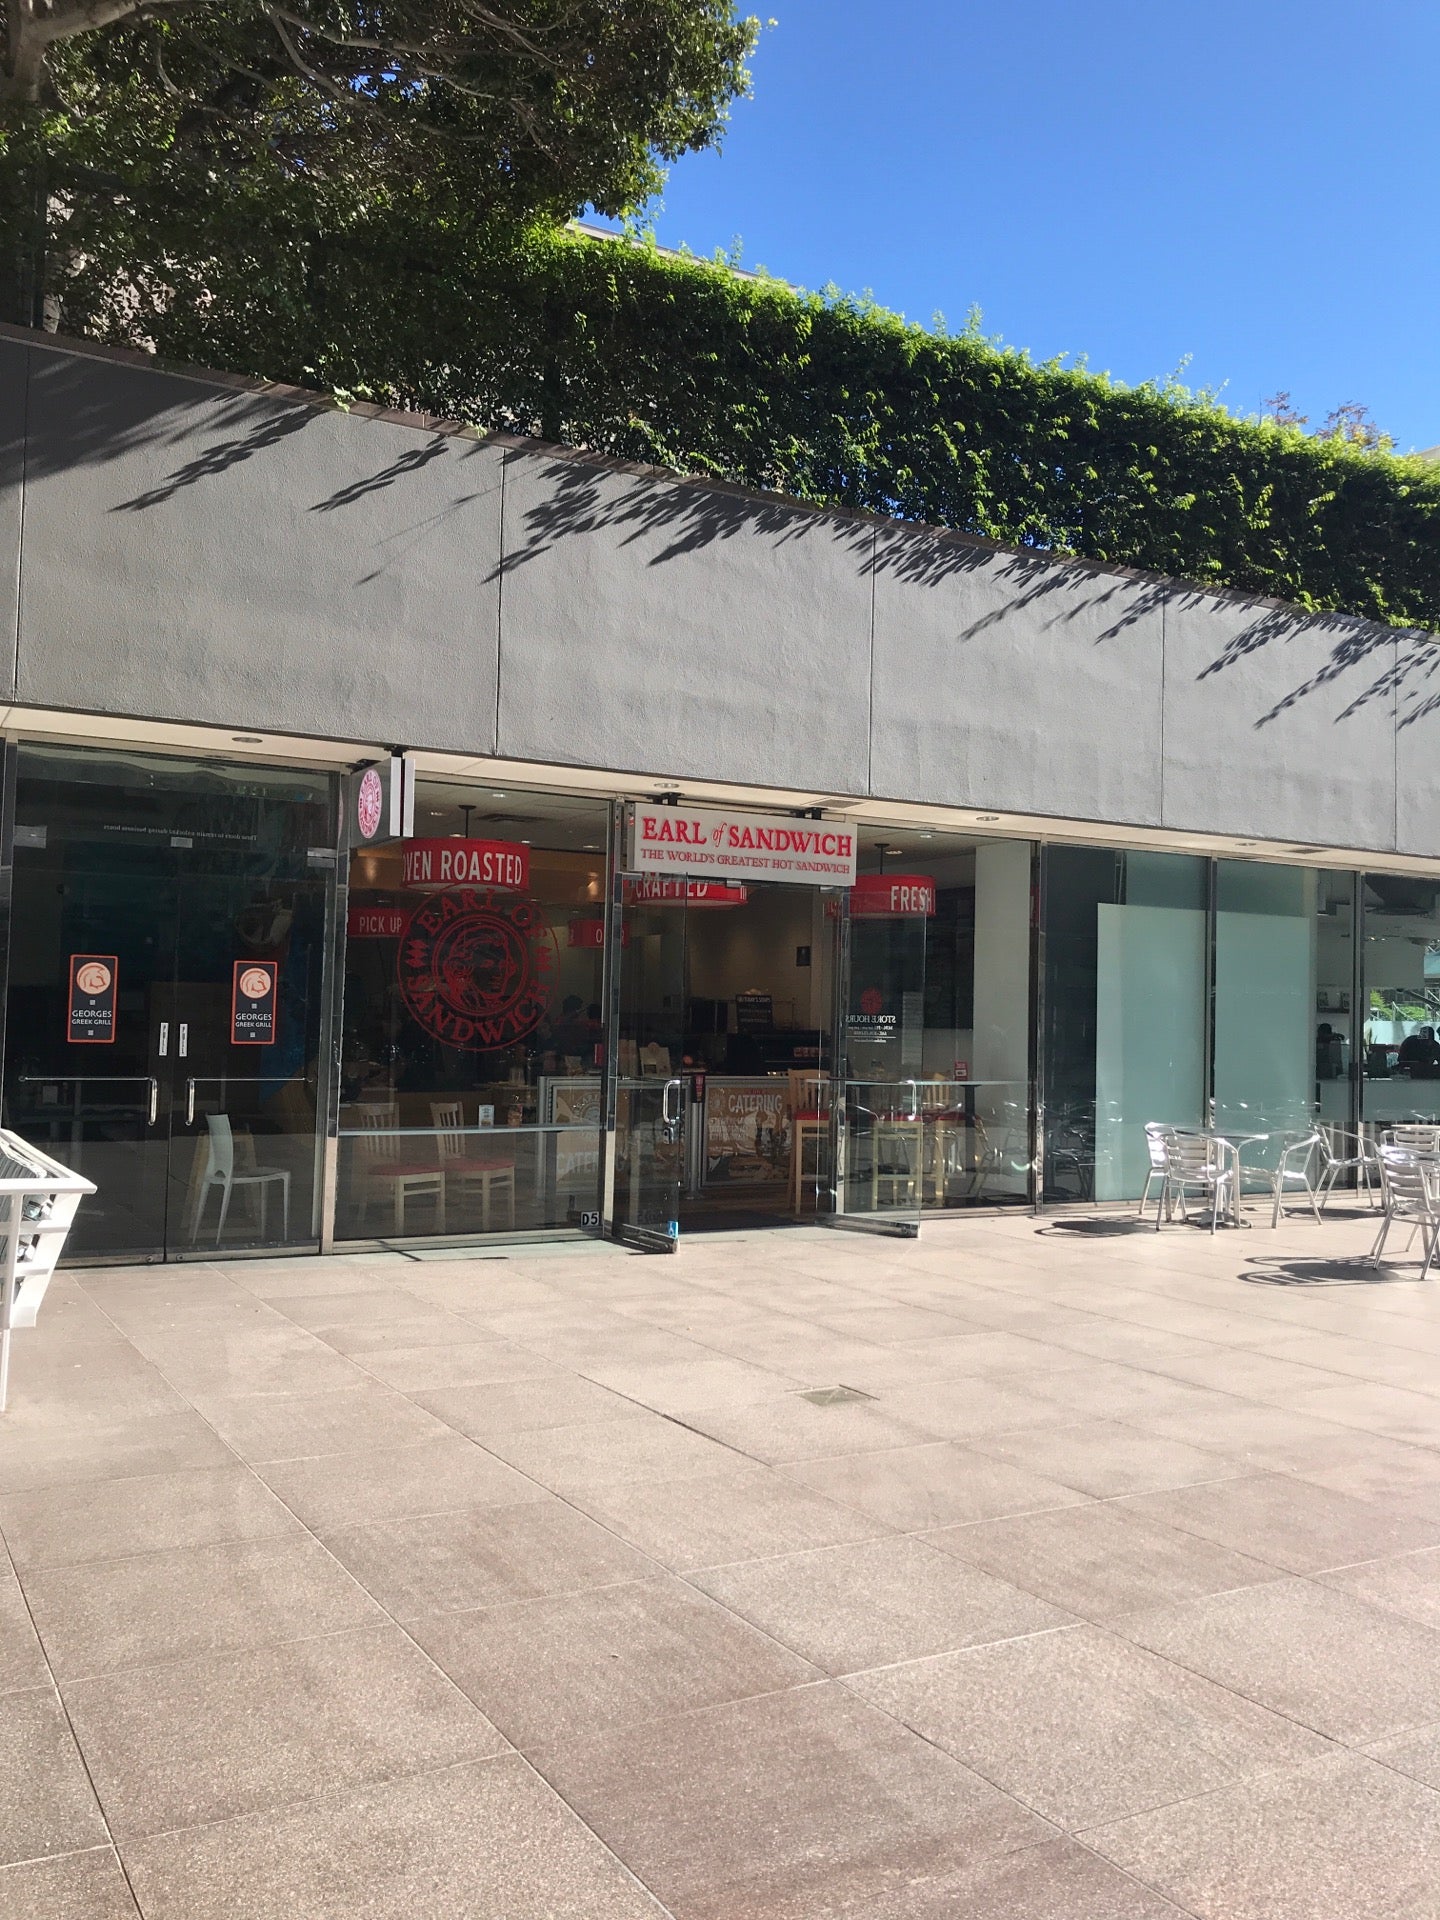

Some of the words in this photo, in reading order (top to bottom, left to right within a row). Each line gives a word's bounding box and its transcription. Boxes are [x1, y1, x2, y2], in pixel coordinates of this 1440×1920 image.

[642, 817, 707, 845] EARL
[712, 822, 727, 848] of
[728, 825, 852, 857] SANDWICH
[441, 850, 522, 884] ROASTED
[640, 848, 664, 860] THE
[667, 850, 715, 864] WORLD'S
[717, 854, 770, 868] GREATEST
[772, 859, 794, 870] HOT
[796, 861, 850, 874] SANDWICH
[359, 916, 385, 933] PICK
[390, 916, 402, 933] UP
[417, 888, 500, 935] EARL
[511, 903, 548, 939] OF
[72, 1009, 112, 1018] GEORGES
[235, 1013, 272, 1021] GEORGES
[407, 975, 550, 1043] SANDWICH
[728, 1094, 782, 1113] CATERING
[582, 1212, 599, 1226] D5
